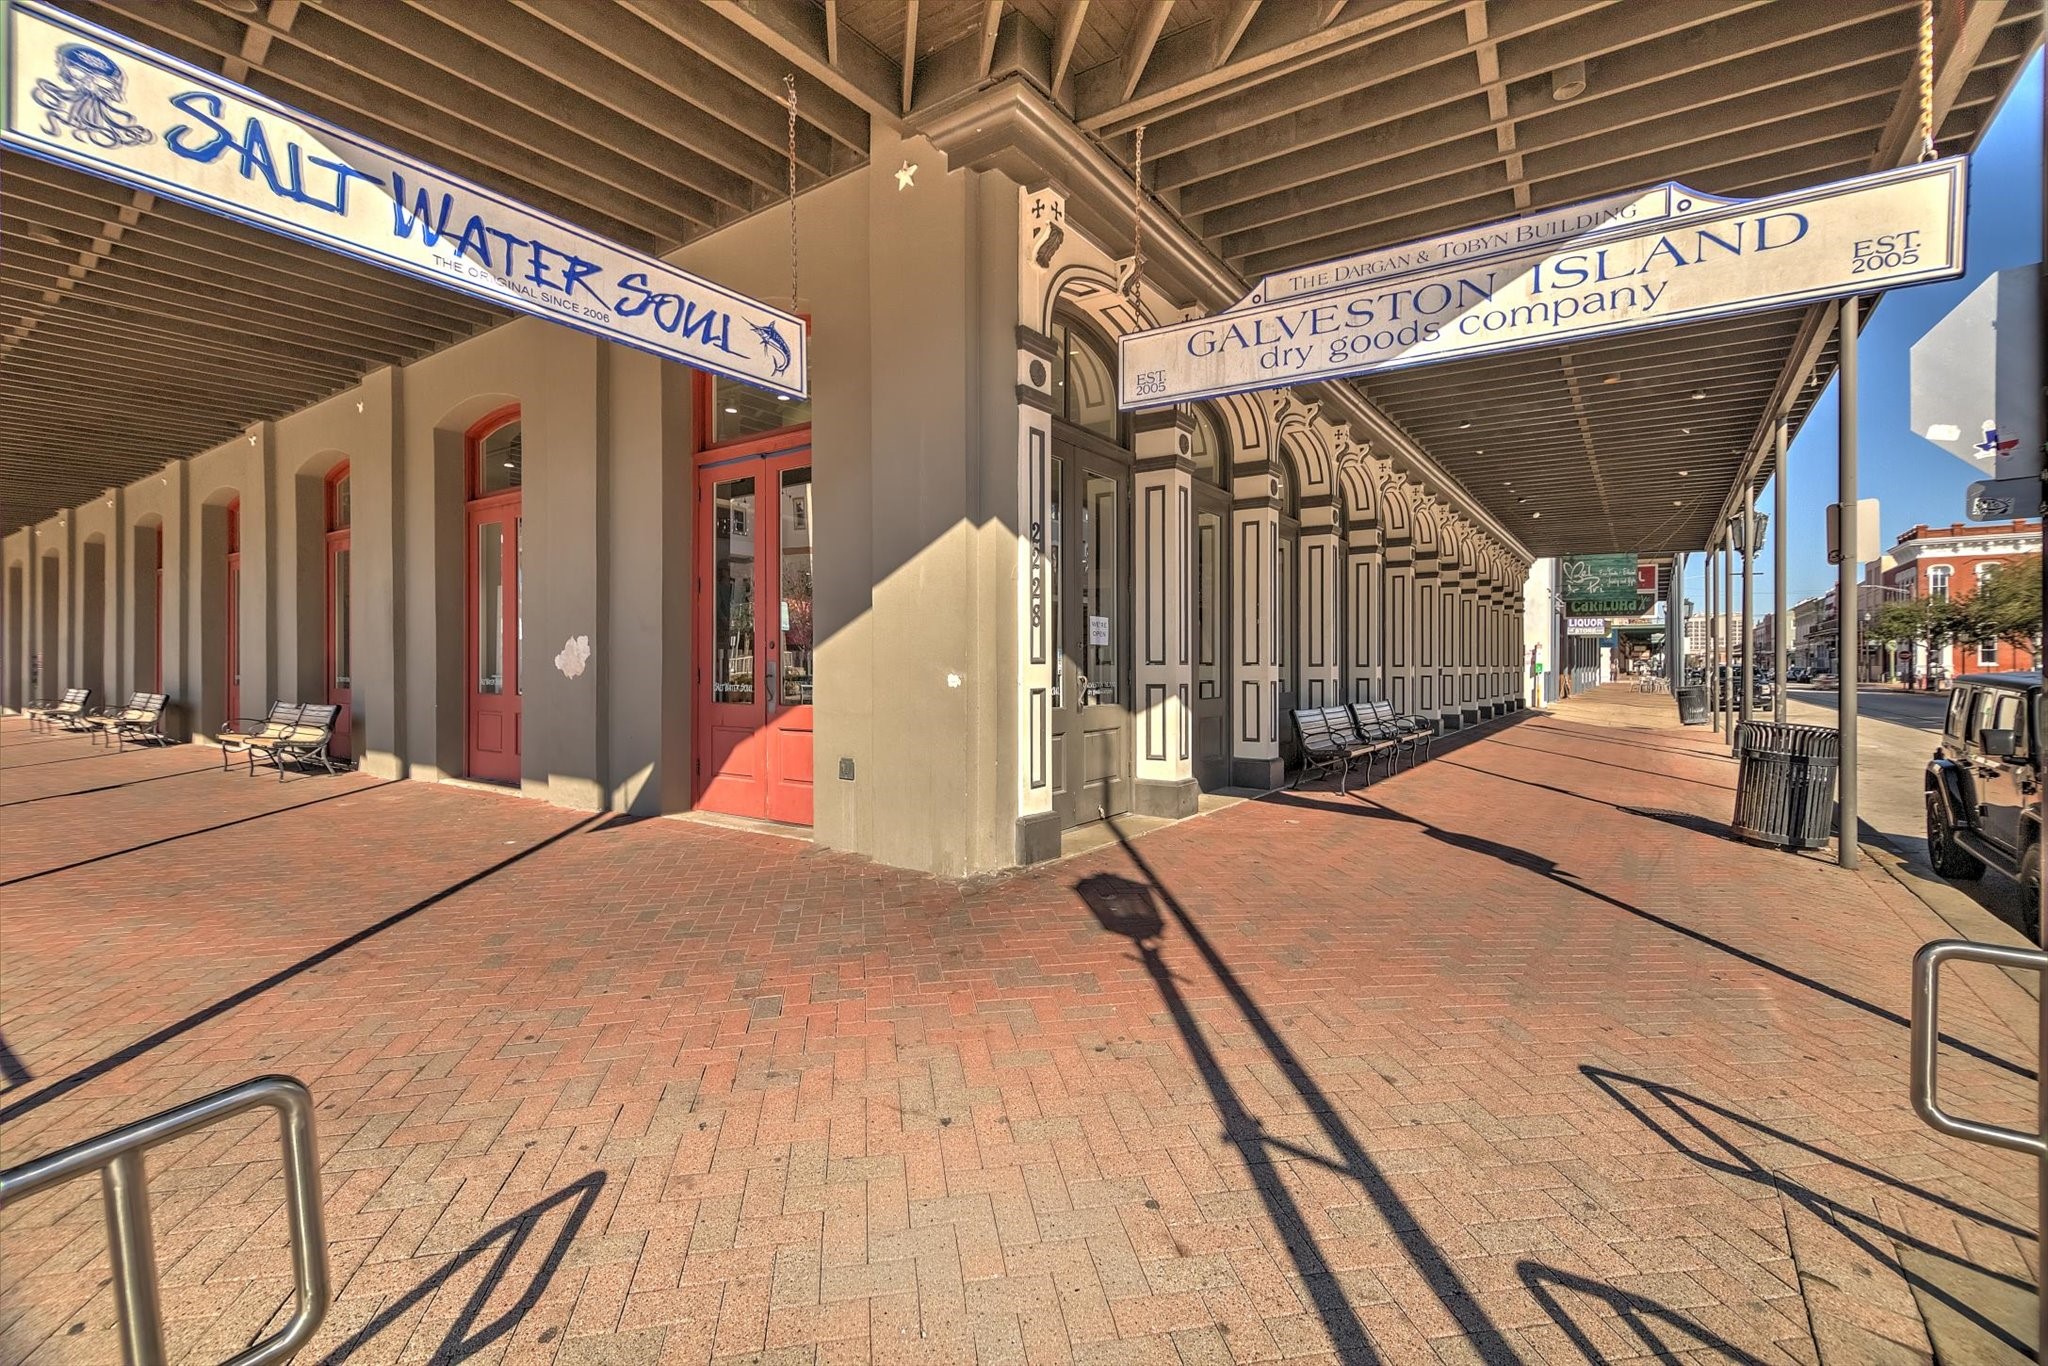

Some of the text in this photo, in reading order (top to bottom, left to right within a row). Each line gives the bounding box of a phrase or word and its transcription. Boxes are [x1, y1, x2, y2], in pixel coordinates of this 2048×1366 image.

[165, 91, 751, 360] SALT WATER SOUL
[1289, 203, 1638, 291] THE DARGAN & TOBYN BUILDING
[1853, 230, 1922, 259] EST.
[432, 254, 611, 323] THE ORIGINAL SINCE 2006
[1187, 212, 1809, 357] GALVESTON ISLAND
[1852, 250, 1920, 274] 2005
[1260, 280, 1669, 370] dry goods company
[1136, 368, 1167, 385] EST.
[1136, 381, 1167, 396] 2005
[1031, 521, 1041, 628] 2228
[1568, 618, 1603, 627] LIQUOR
